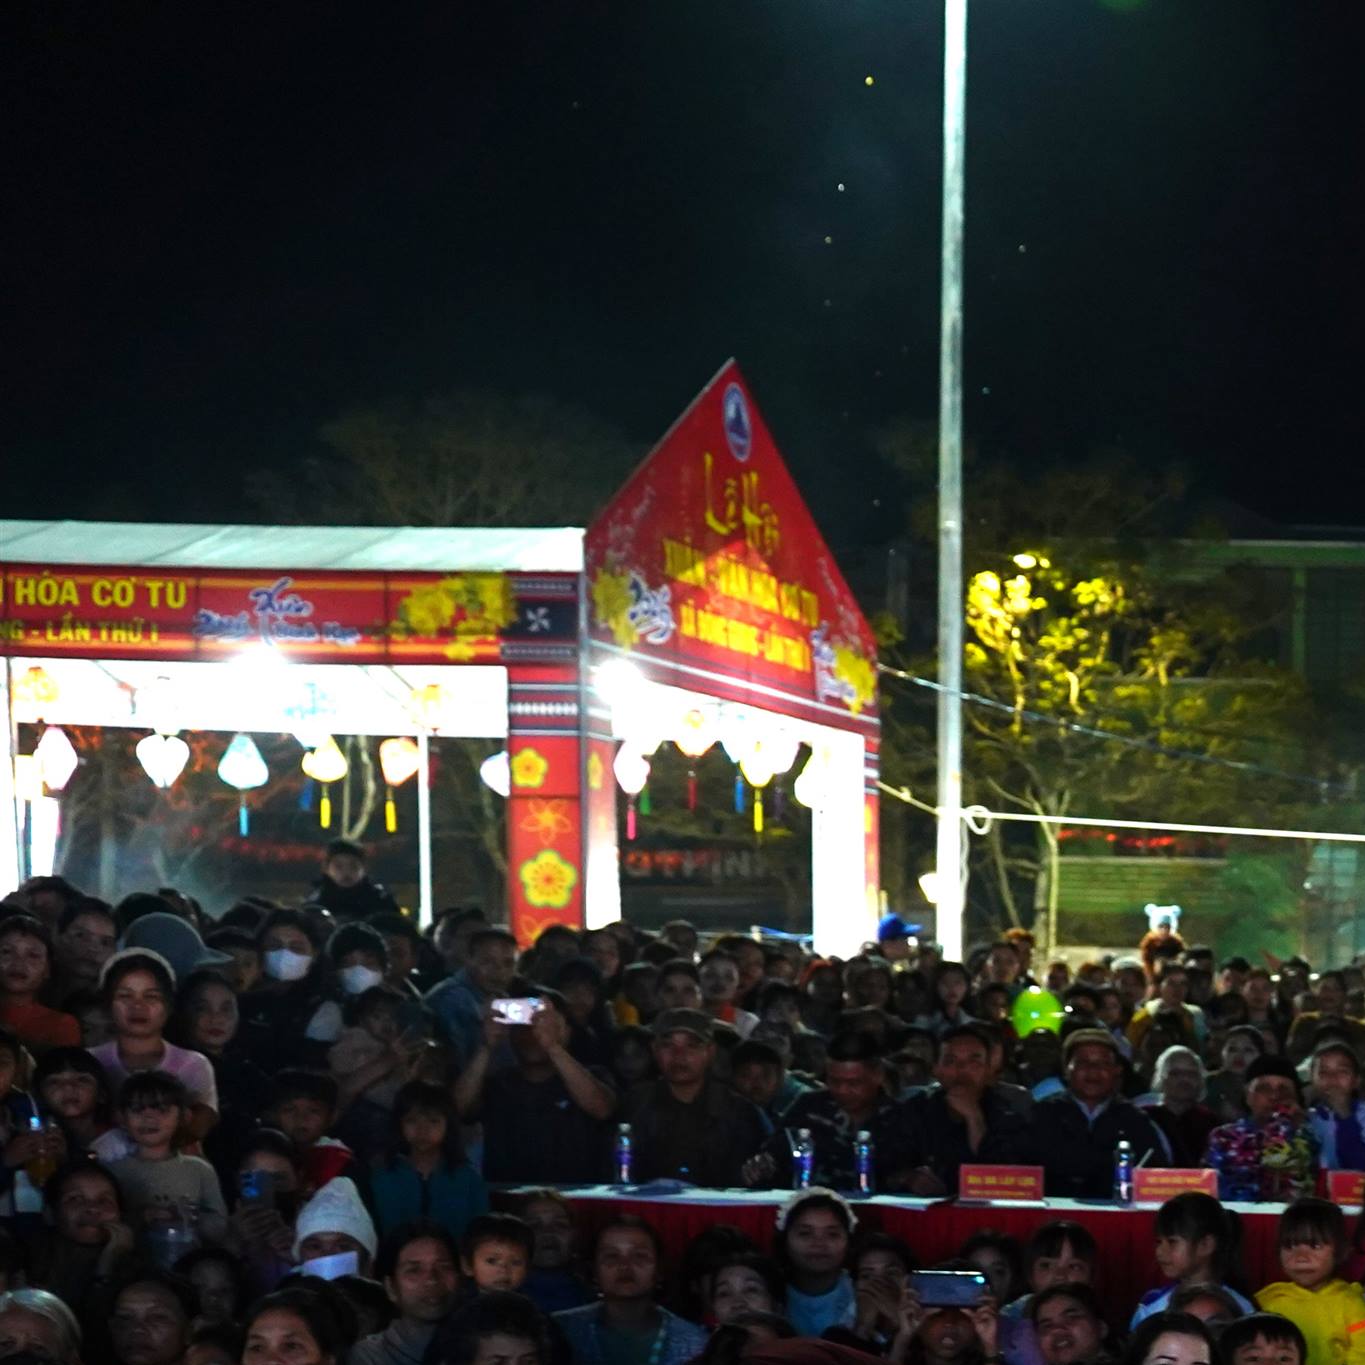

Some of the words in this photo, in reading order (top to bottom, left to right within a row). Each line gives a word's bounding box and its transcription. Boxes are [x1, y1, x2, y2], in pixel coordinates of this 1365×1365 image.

[14, 570, 80, 607] HÓA
[91, 576, 135, 608] CƠ
[144, 579, 188, 610] TU
